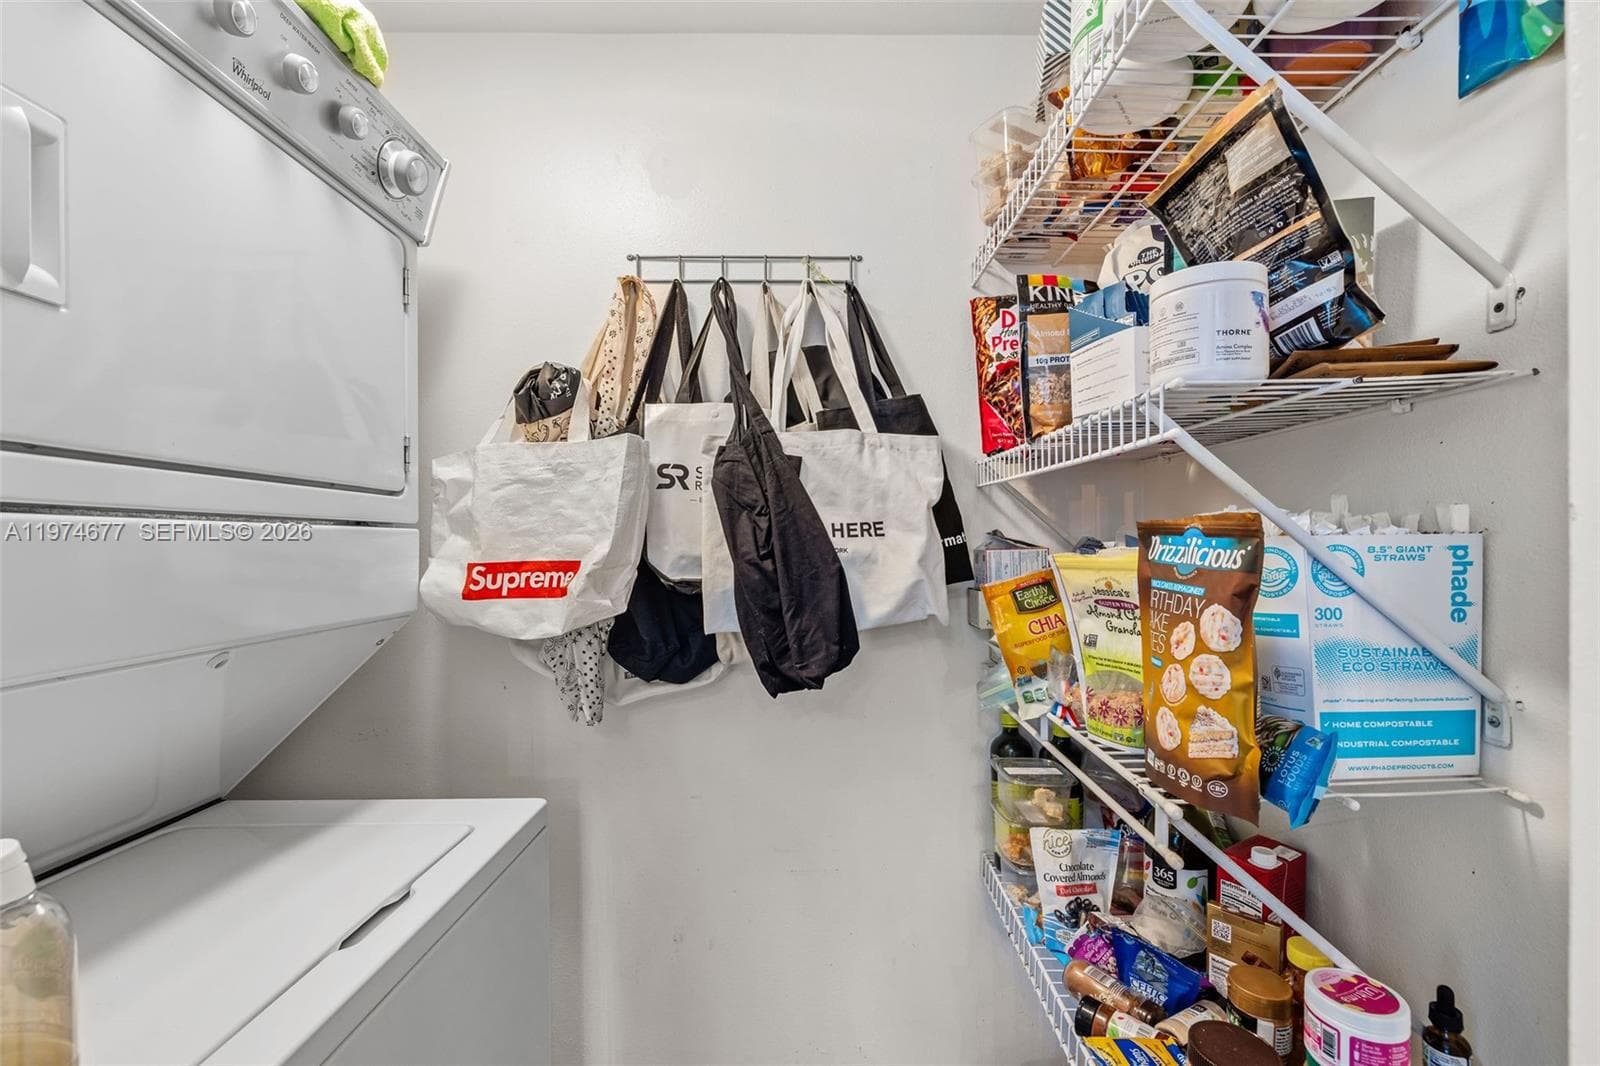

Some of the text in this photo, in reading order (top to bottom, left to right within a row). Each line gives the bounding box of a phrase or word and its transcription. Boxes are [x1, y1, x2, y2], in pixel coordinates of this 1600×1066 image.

[232, 60, 271, 101] Whirlpool
[656, 463, 690, 490] SR
[831, 521, 886, 539] HERE
[1148, 535, 1246, 570] Drizzilicious
[1395, 545, 1433, 553] GIANT
[1374, 554, 1426, 562] STRAWS
[468, 565, 575, 597] Supreme
[1447, 544, 1474, 624] phade
[1015, 584, 1048, 601] Earthly
[1092, 586, 1130, 598] Jessica's
[1024, 594, 1056, 609] Choice
[1150, 589, 1206, 619] RTHDAY
[1086, 604, 1123, 621] Almond
[1314, 607, 1343, 621] 300
[1028, 613, 1066, 635] CHIA
[1105, 620, 1142, 637] Granola
[1342, 661, 1451, 672] ECO STRAWS
[1363, 720, 1433, 728] COMPOSTABLE
[1337, 738, 1460, 748] NDUSTRIAL COMPOSTABLE
[1278, 750, 1300, 783] LOTUS
[1285, 752, 1307, 788] FOODS
[1059, 861, 1095, 872] Chocolate
[1153, 866, 1174, 882] 365
[1043, 871, 1107, 883] Covered Almonds
